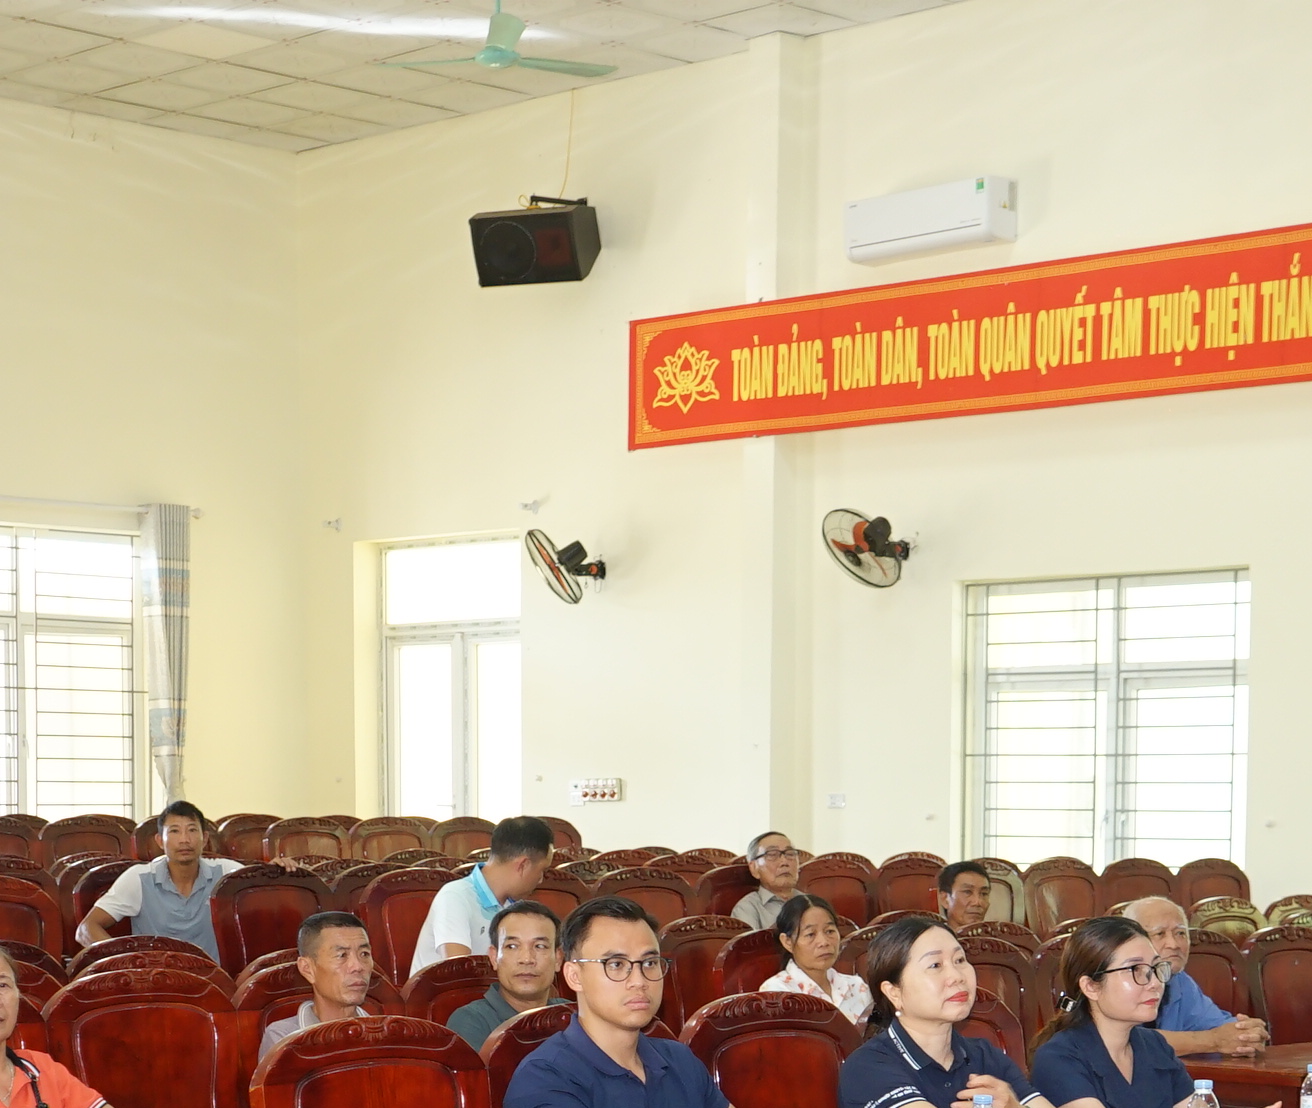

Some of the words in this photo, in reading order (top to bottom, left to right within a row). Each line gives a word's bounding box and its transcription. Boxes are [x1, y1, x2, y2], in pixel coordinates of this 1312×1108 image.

[731, 335, 774, 401] TOÀN
[777, 323, 827, 399] ĐẢNG,
[832, 322, 877, 391] TOÀN
[880, 316, 922, 389] DÂN,
[927, 309, 976, 381] TOÀN
[979, 302, 1031, 381] QUÂN
[1035, 285, 1096, 375] QUYẾT
[1099, 286, 1144, 360] TÂM
[1147, 284, 1201, 366] THỰC
[1204, 271, 1256, 361] HIỆN
